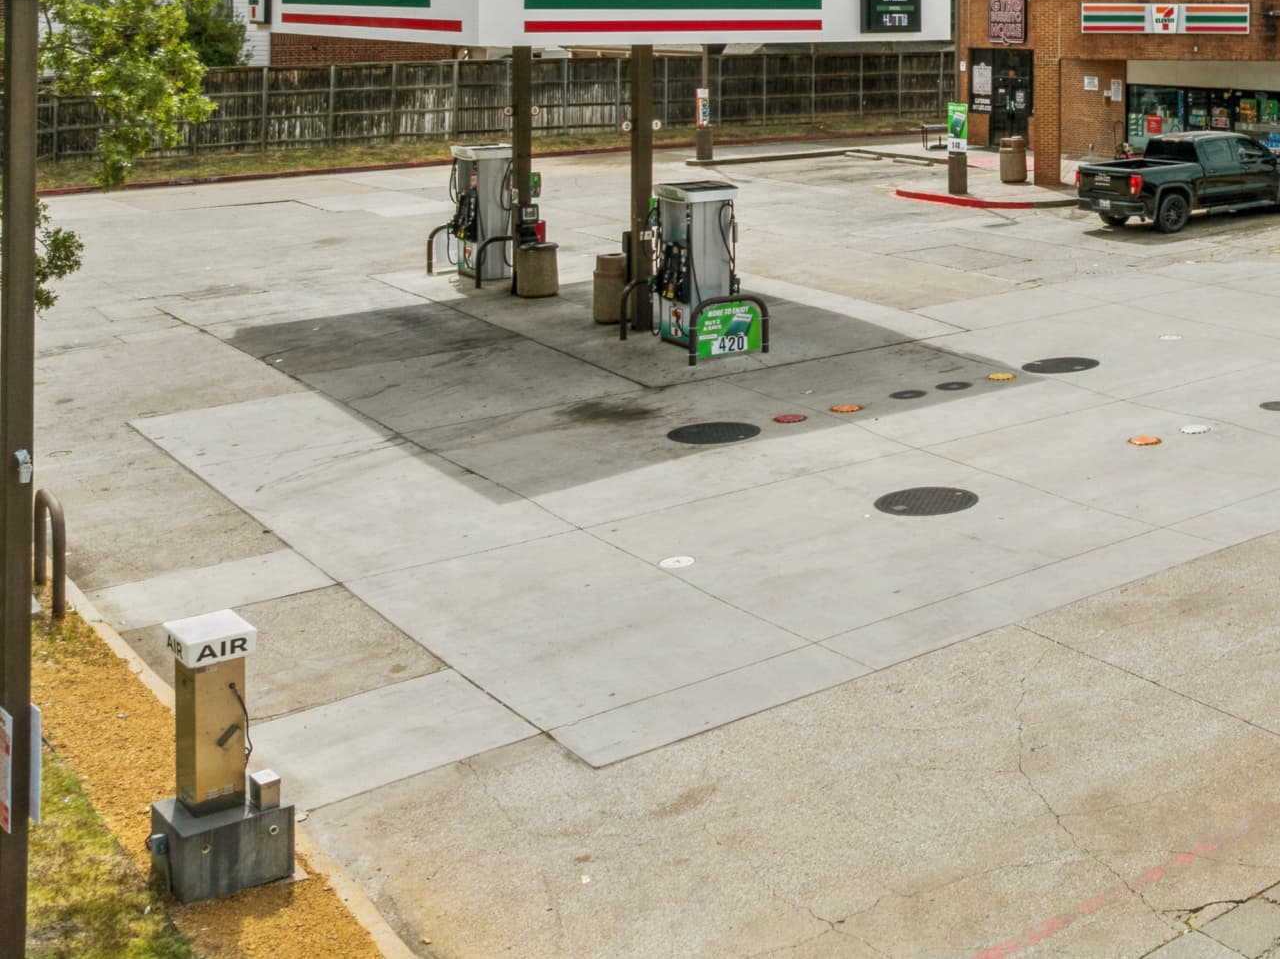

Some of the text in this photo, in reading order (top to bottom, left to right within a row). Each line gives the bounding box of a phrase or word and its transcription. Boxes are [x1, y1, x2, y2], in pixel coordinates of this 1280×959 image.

[991, 23, 1022, 37] HOUSE
[708, 309, 723, 317] MORE
[732, 306, 749, 314] ENJOY
[719, 336, 745, 352] 420
[166, 633, 183, 660] AIR
[196, 637, 248, 663] AIR
